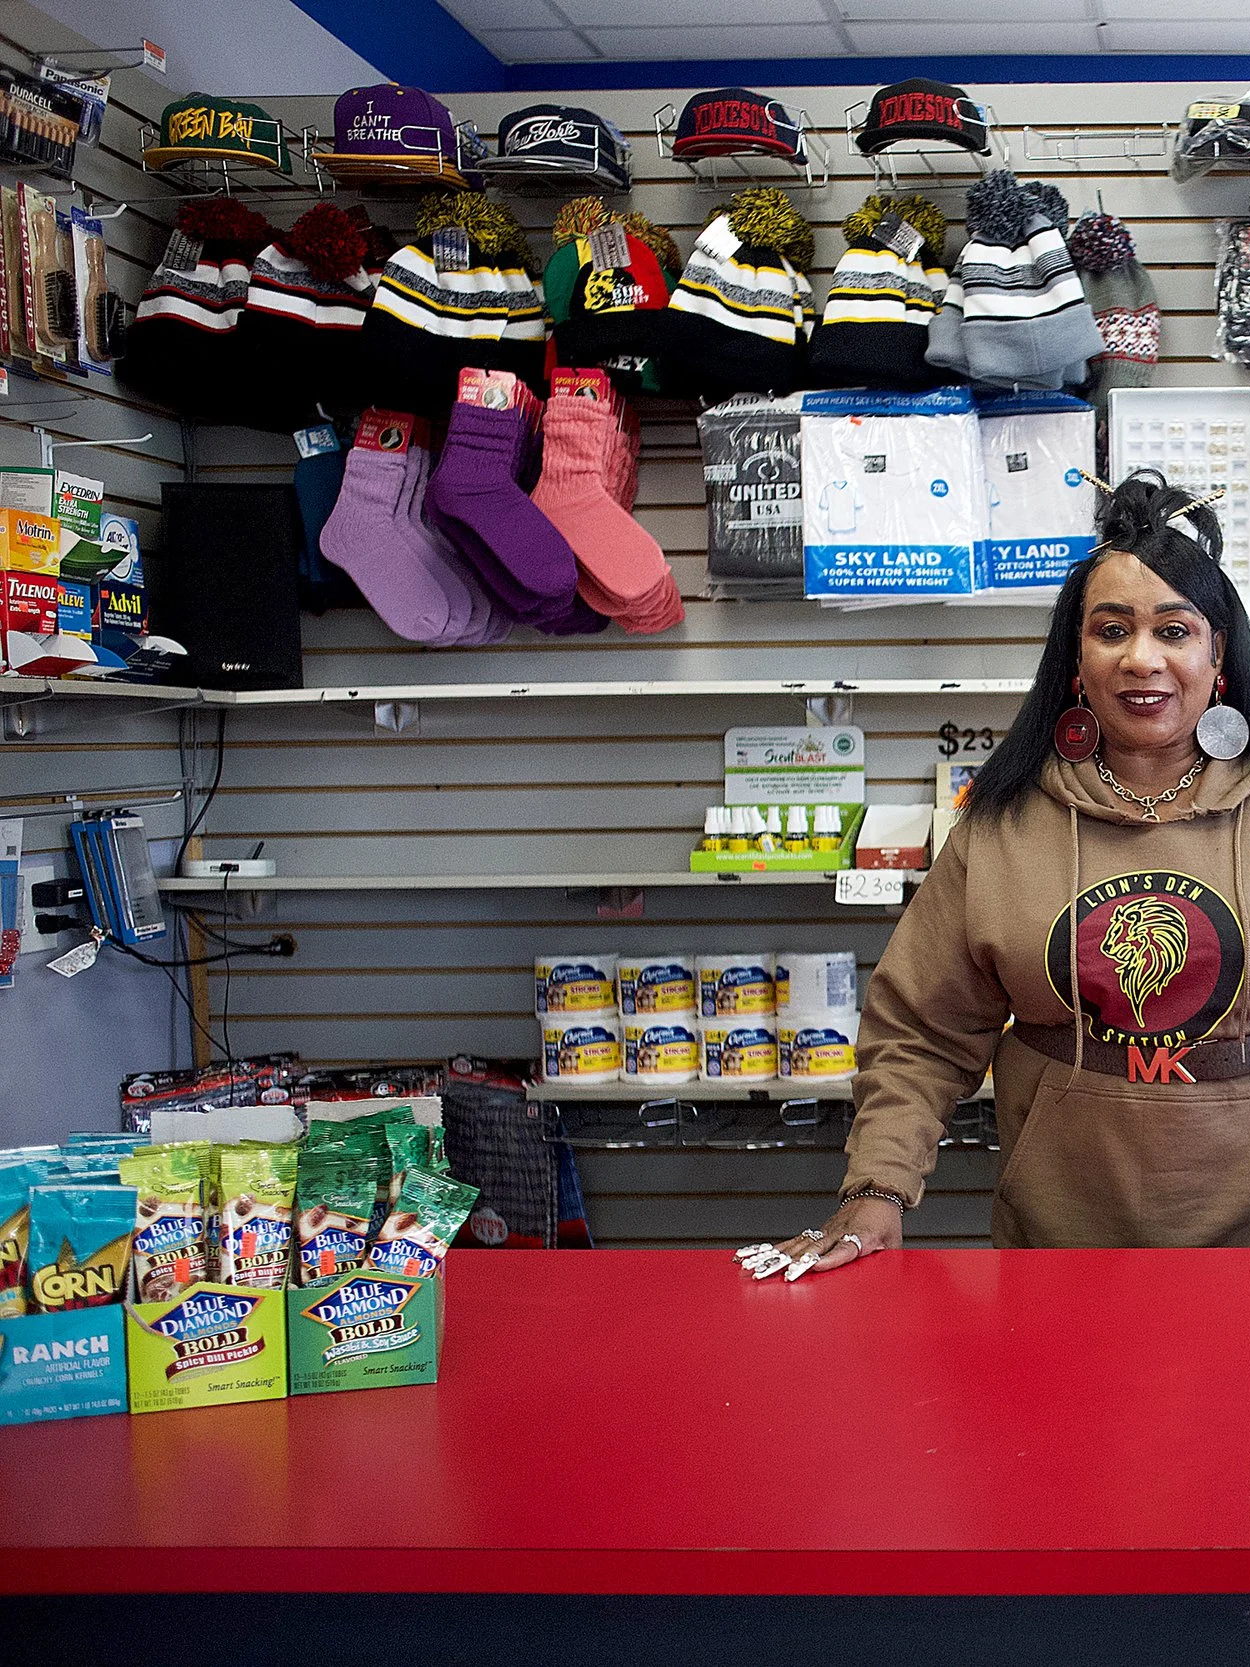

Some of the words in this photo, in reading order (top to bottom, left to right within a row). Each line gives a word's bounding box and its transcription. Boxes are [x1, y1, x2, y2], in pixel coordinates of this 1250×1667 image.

[10, 83, 53, 111] DURACELL
[366, 100, 373, 114] I
[168, 107, 215, 145] GREEN
[217, 111, 253, 149] BAY
[353, 115, 391, 128] CAN'T
[347, 128, 401, 142] BREATHE
[19, 206, 31, 276] BEAUTY
[25, 285, 34, 329] PLUS
[605, 355, 649, 371] LEY
[555, 377, 579, 385] SPORTS
[580, 378, 601, 386] SOCKS
[60, 482, 100, 501] EXCEDRIN
[729, 483, 800, 502] UNITED
[58, 506, 89, 519] STRENGTH
[59, 498, 77, 508] EXTRA
[17, 519, 51, 541] Motrin
[835, 552, 876, 566] SKY
[883, 552, 942, 566] LAND
[1015, 544, 1070, 558] LAND
[822, 568, 853, 577] 100%
[856, 568, 903, 577] COTTON
[904, 568, 954, 577] T-SHIRTS
[1035, 560, 1078, 569] T-SHIR
[828, 578, 864, 587] SUPER
[867, 578, 904, 587] HEAVY
[906, 578, 949, 587] WEIGHT
[1000, 571, 1034, 580] HEAVY
[8, 579, 56, 600] TYLENOL
[57, 593, 84, 608] ALEVE
[108, 592, 141, 614] Advil
[938, 720, 994, 760] $23
[1084, 875, 1153, 908] LION'S
[1165, 877, 1204, 901] DEN
[1102, 1029, 1187, 1048] STATION
[1127, 1045, 1196, 1084] MK
[135, 1221, 203, 1252] DIAMOND
[151, 1218, 186, 1237] BLUE
[242, 1220, 276, 1236] BLUE
[222, 1227, 291, 1252] DIMOND
[315, 1232, 350, 1249] BLUE
[153, 1244, 199, 1266] BOLD
[301, 1239, 366, 1263] DIOND
[390, 1240, 423, 1259] BLUE
[240, 1250, 284, 1270] BOLD
[370, 1247, 437, 1272] DIAMD
[151, 1267, 172, 1278] Spicy
[235, 1270, 255, 1281] Spicy
[33, 1265, 115, 1307] CORN
[340, 1283, 384, 1304] BLUE
[182, 1296, 228, 1317] BLUE
[318, 1288, 408, 1322] DIAMOND
[161, 1301, 253, 1336] DIAMOND
[340, 1307, 393, 1325] ALMONDS
[182, 1321, 237, 1339] ALMONDS
[340, 1318, 395, 1341] BOLD
[13, 1335, 109, 1364] RANCH
[184, 1332, 240, 1355] BOLD
[324, 1341, 361, 1361] Wasabi
[372, 1336, 390, 1349] Soy
[391, 1328, 418, 1345] Sauce
[83, 1357, 110, 1370] FLAVOR
[176, 1358, 205, 1370] Spicy
[207, 1354, 225, 1363] Dill
[227, 1345, 259, 1360] Pickle
[55, 1372, 74, 1383] CORN
[75, 1370, 104, 1380] KERNELS
[363, 1366, 388, 1376] Smart
[207, 1382, 233, 1392] Smart
